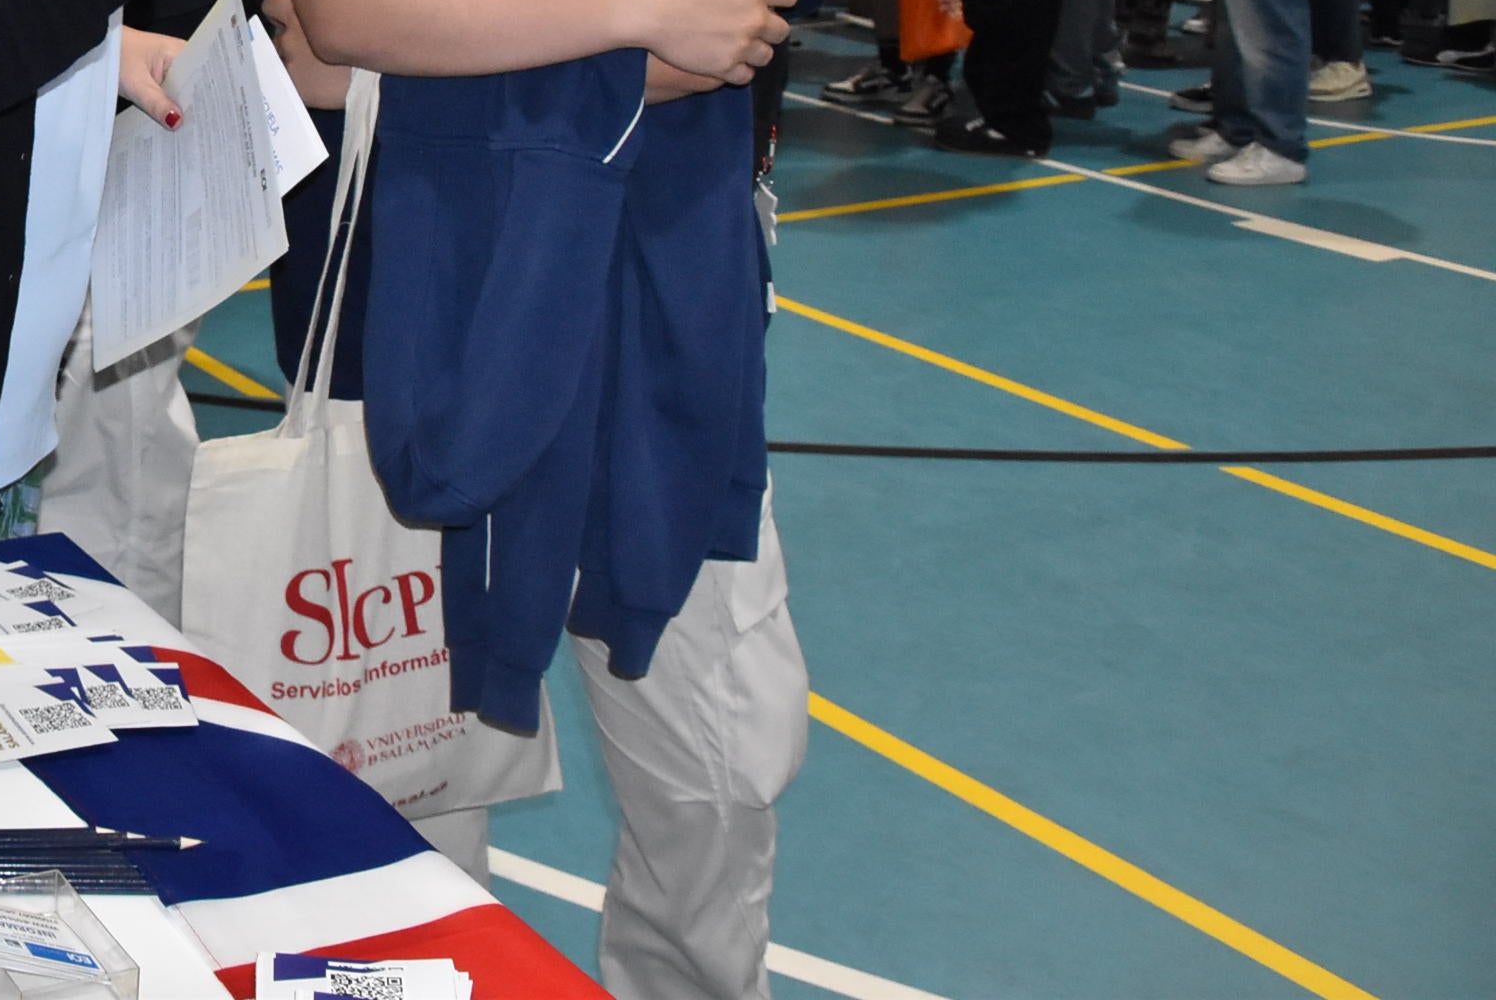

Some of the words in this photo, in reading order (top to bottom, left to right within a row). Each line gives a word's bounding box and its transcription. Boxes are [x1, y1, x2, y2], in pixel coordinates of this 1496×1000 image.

[271, 677, 362, 700] Servicios
[366, 711, 466, 750] VNIVERSIDAD
[67, 951, 92, 965] EOI
